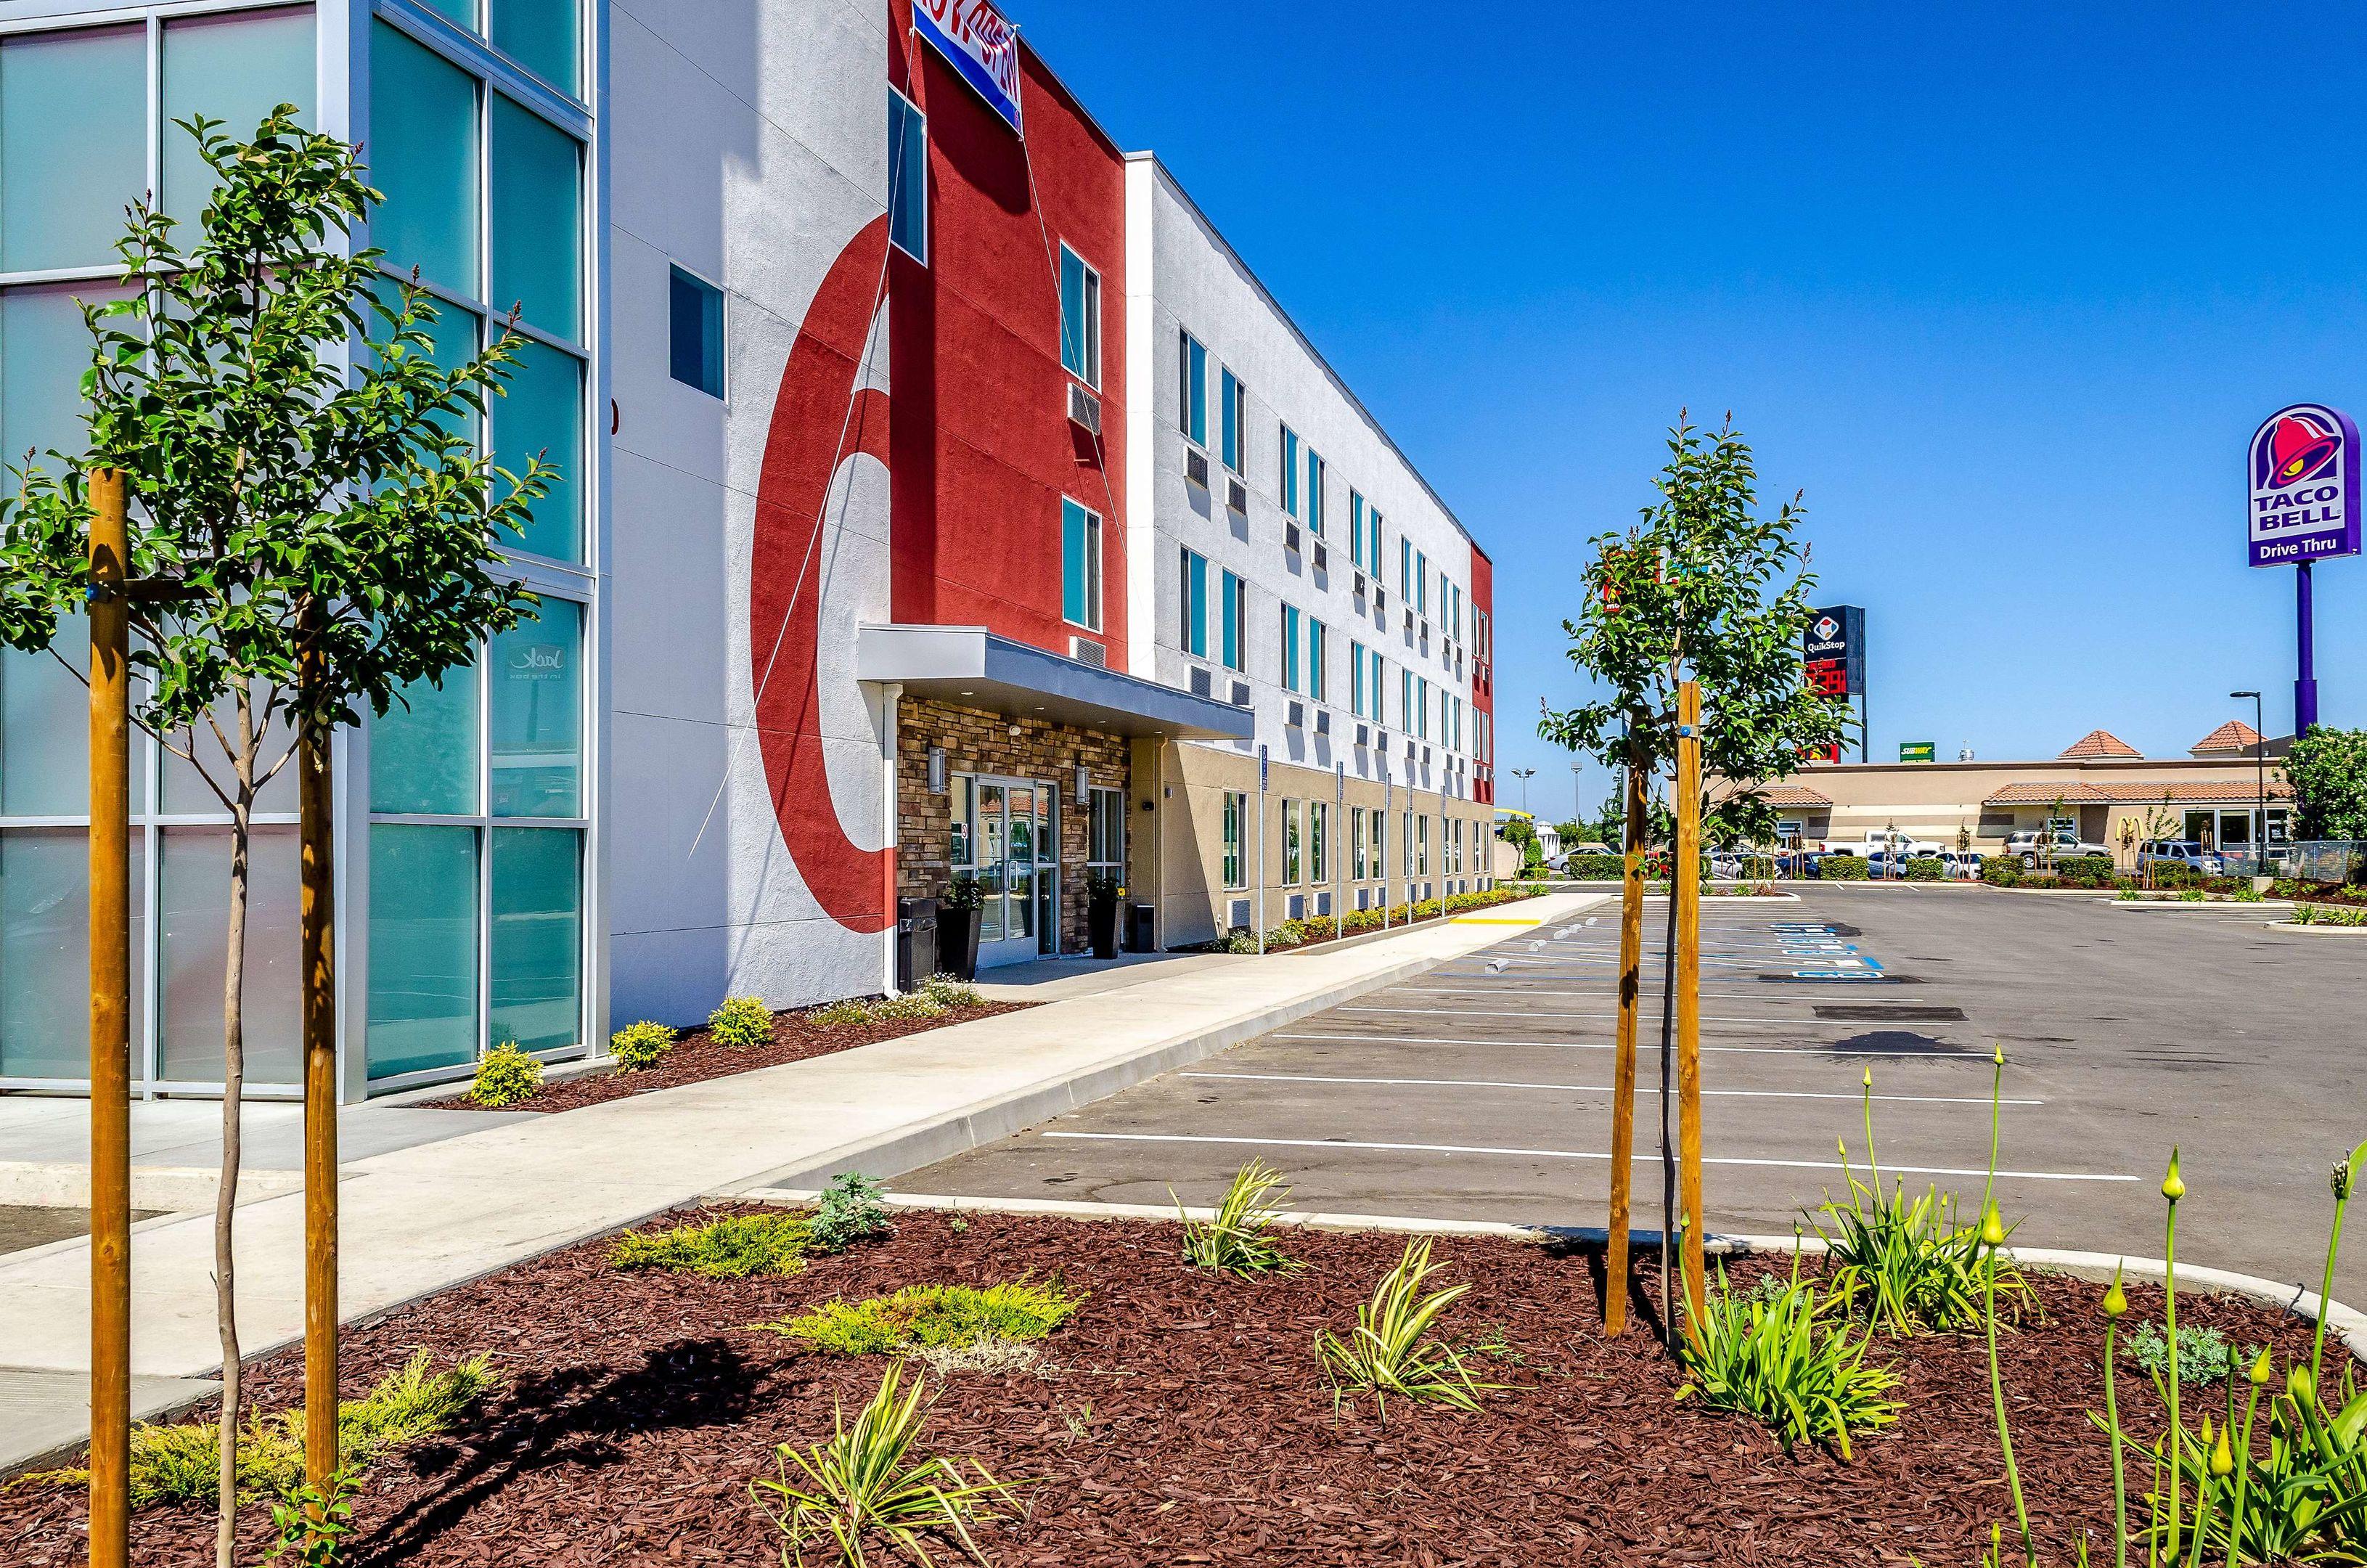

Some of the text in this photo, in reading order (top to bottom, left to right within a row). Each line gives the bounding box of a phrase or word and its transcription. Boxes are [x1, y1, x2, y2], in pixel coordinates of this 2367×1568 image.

[2253, 486, 2339, 512] TACO
[2259, 506, 2342, 531] BELL
[2260, 538, 2337, 559] Drive Thru
[1807, 641, 1846, 653] QuikStop
[1901, 746, 1932, 755] SUBWAY
